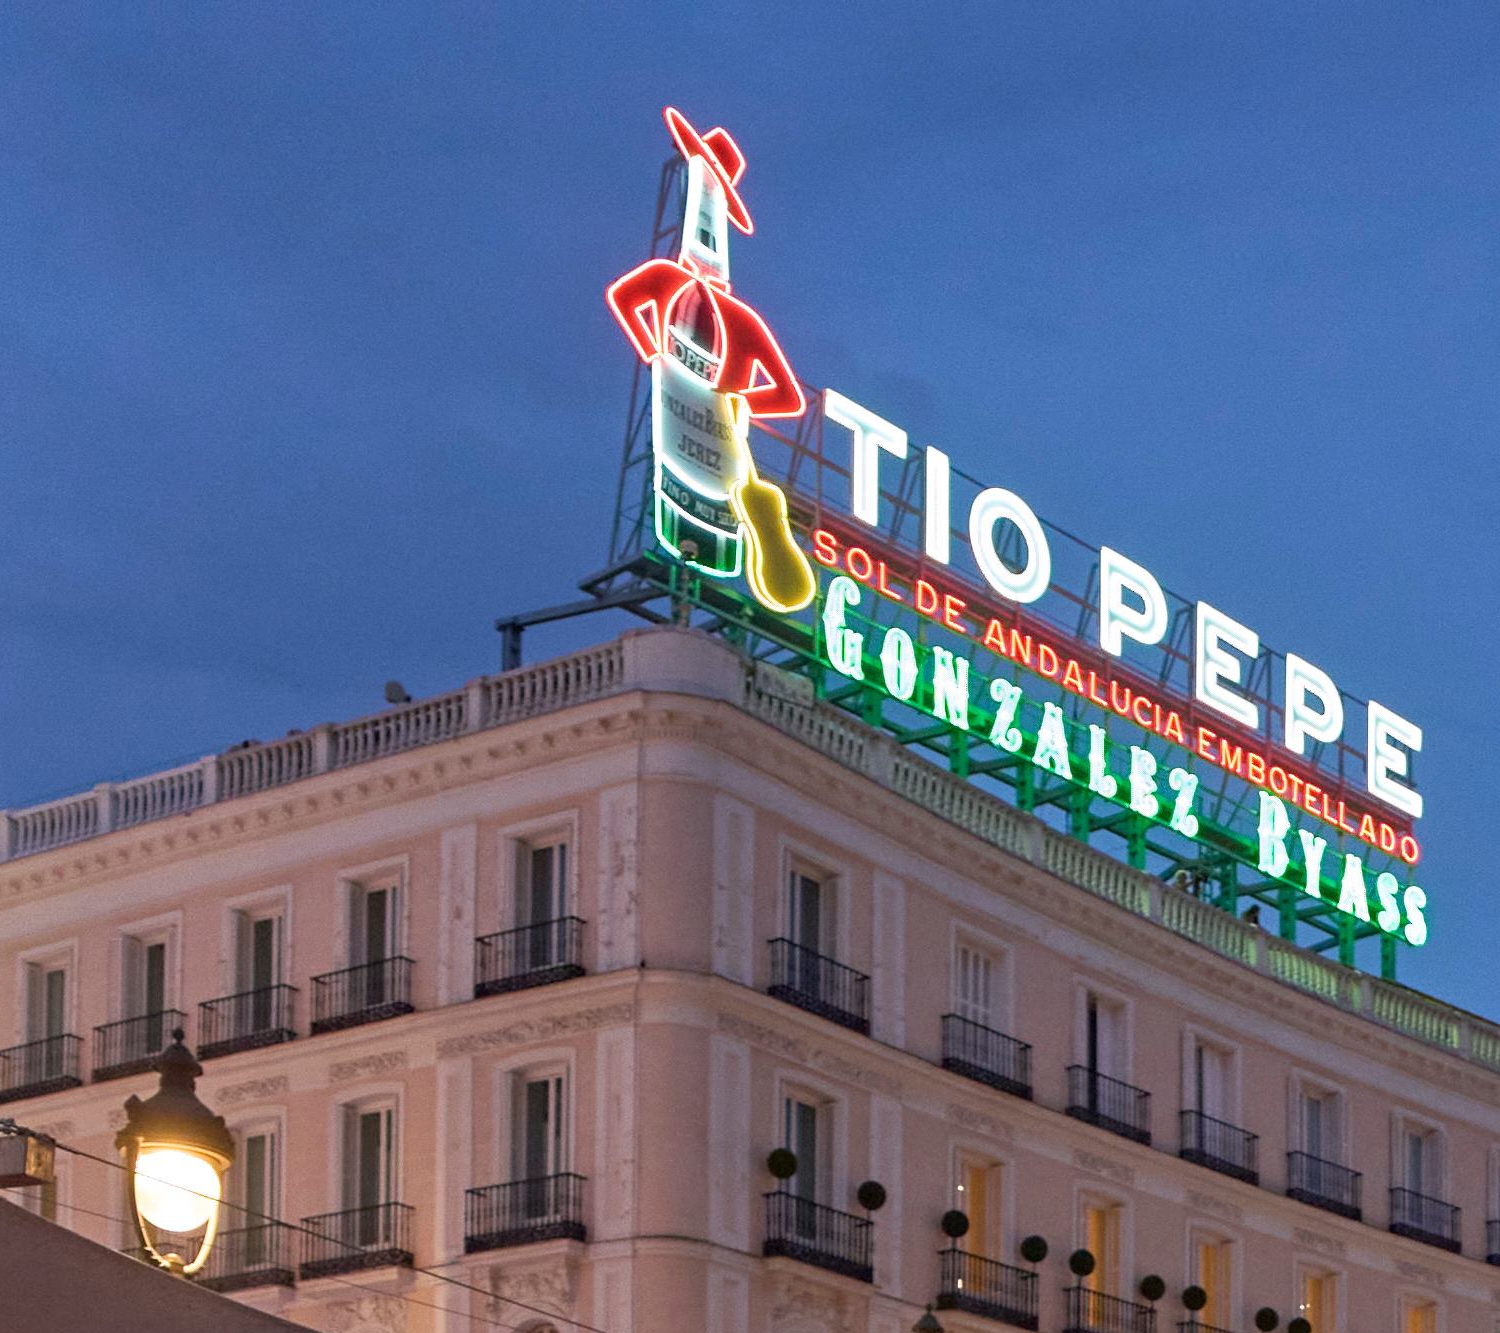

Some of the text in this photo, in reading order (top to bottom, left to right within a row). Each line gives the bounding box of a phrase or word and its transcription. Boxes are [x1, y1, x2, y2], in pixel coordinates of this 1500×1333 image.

[812, 527, 1421, 867] SOL DE ANDALUCIA EMBOTELLADO
[821, 574, 1430, 949] GONZALEZ BYASS
[823, 388, 1425, 819] TIO PEPE
